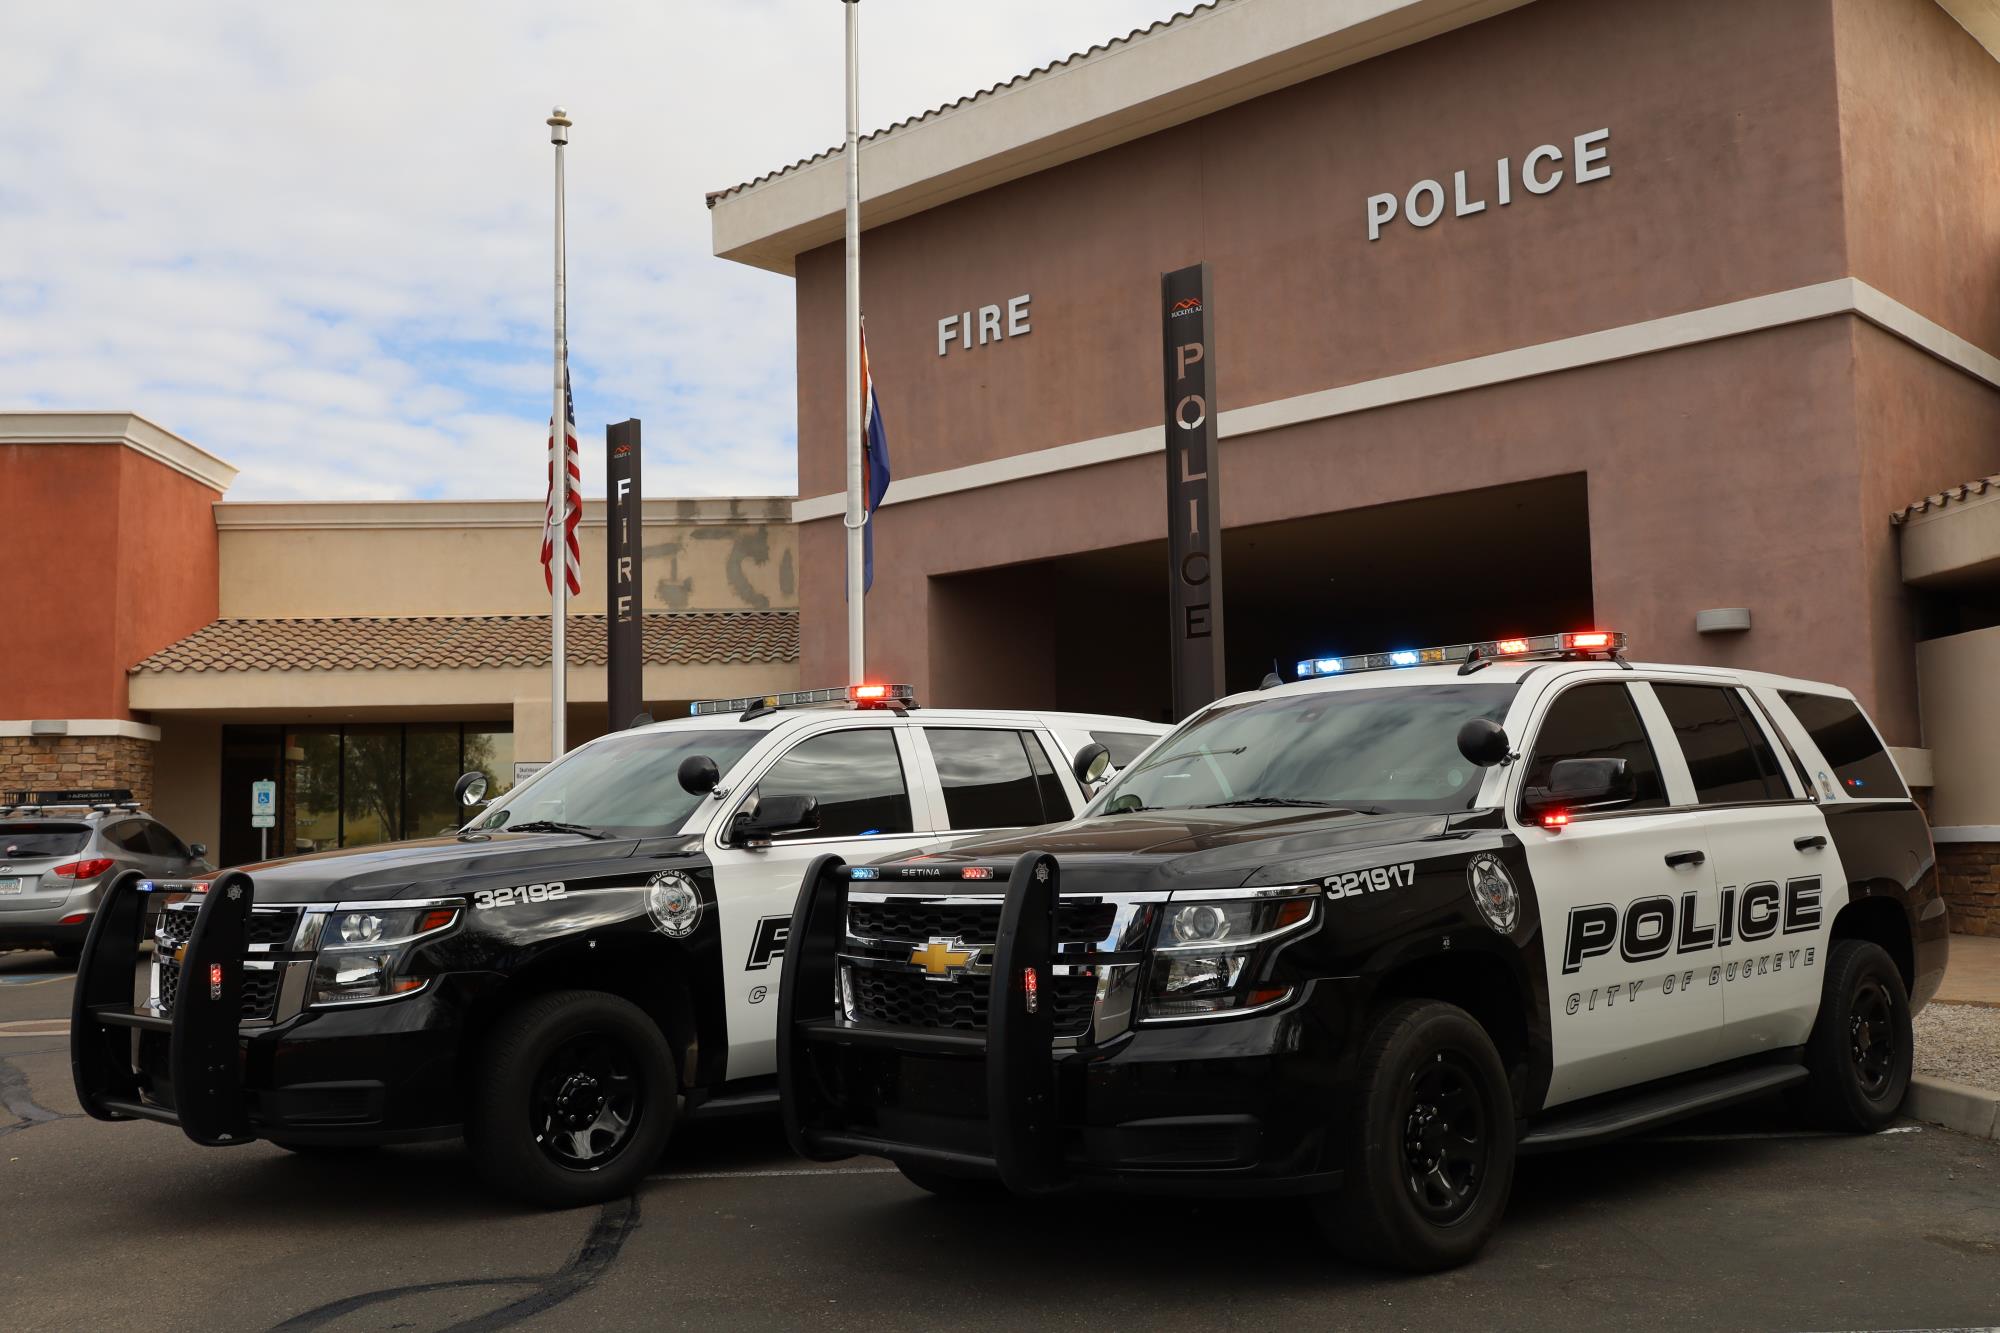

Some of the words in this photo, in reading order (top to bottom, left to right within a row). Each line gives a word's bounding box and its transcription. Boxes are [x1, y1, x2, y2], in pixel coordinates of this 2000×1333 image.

[1367, 127, 1611, 240] POLICE
[938, 293, 1031, 356] FIRE
[1175, 342, 1212, 640] POLICE
[617, 478, 632, 622] FIRE
[473, 881, 568, 910] 32192
[650, 870, 692, 884] BUCKEYE
[901, 868, 941, 877] SETINA
[1323, 862, 1415, 900] 321917
[663, 926, 693, 937] POLICE
[1562, 873, 1823, 975] POLICE
[1565, 980, 1643, 1016] CITY
[1662, 970, 1694, 995] OF
[1708, 947, 1816, 986] BUCKEYE
